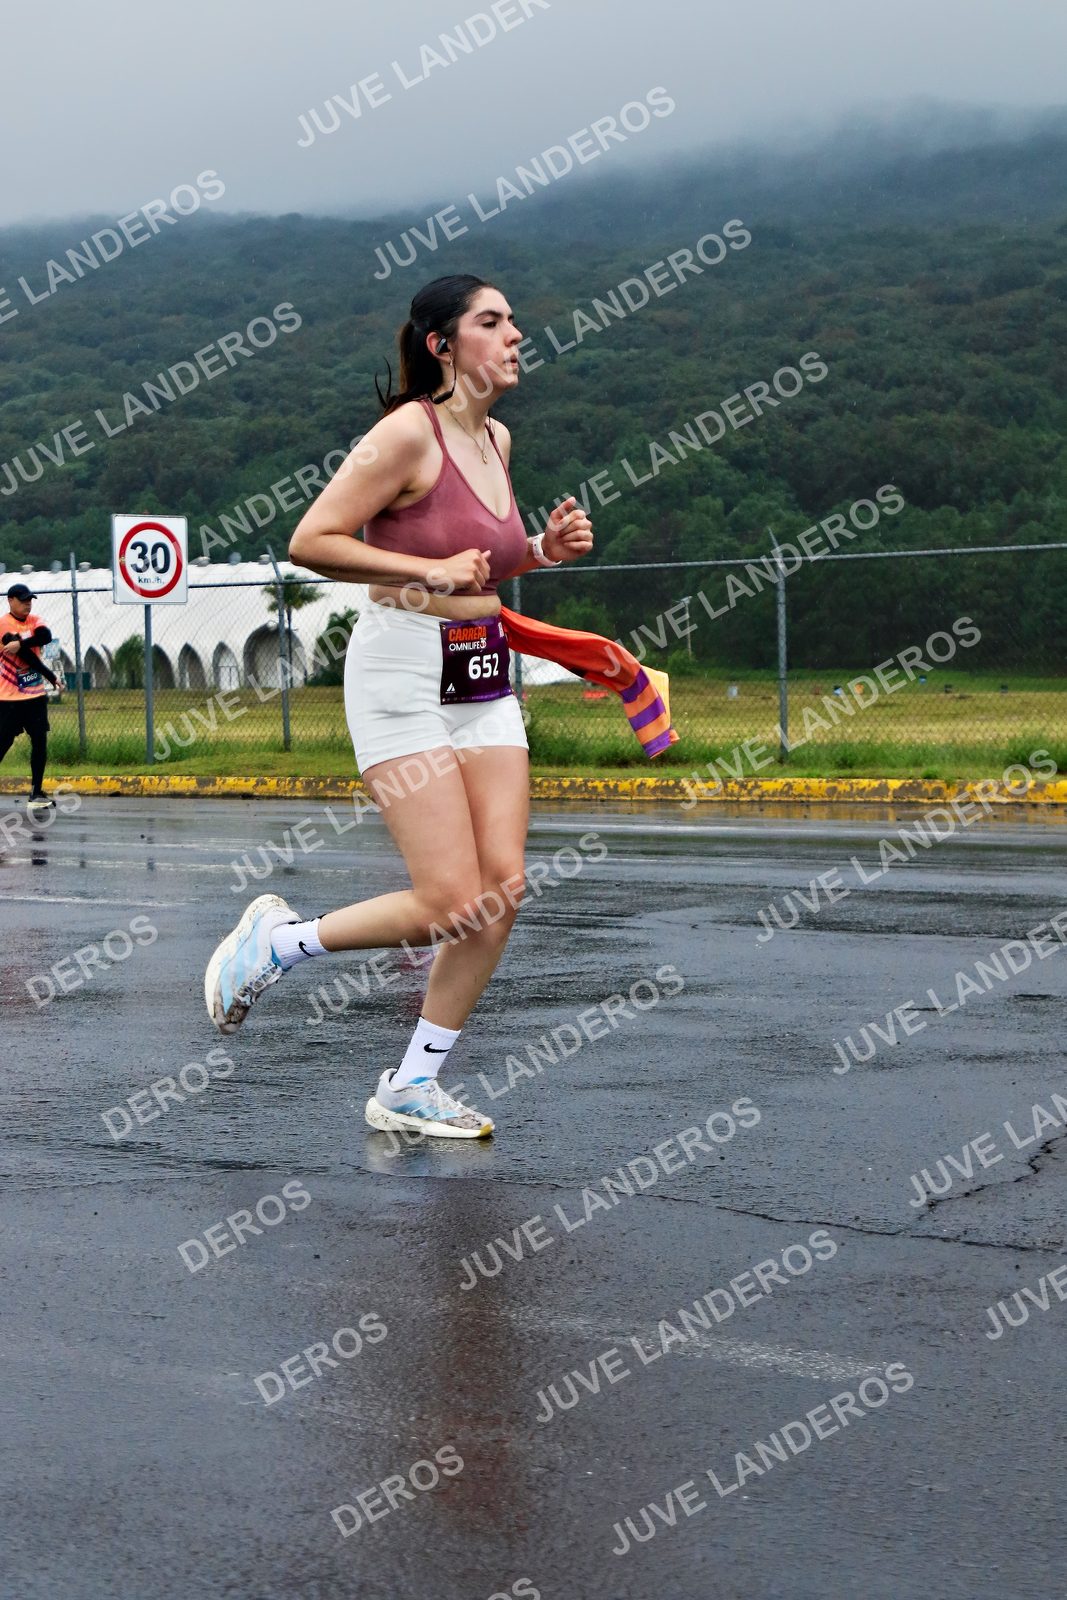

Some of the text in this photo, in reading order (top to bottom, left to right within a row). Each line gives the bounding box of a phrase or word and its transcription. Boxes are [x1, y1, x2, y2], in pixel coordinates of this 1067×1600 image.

[130, 541, 170, 574] 30
[449, 640, 480, 651] OMNILIFE
[468, 652, 499, 679] 652
